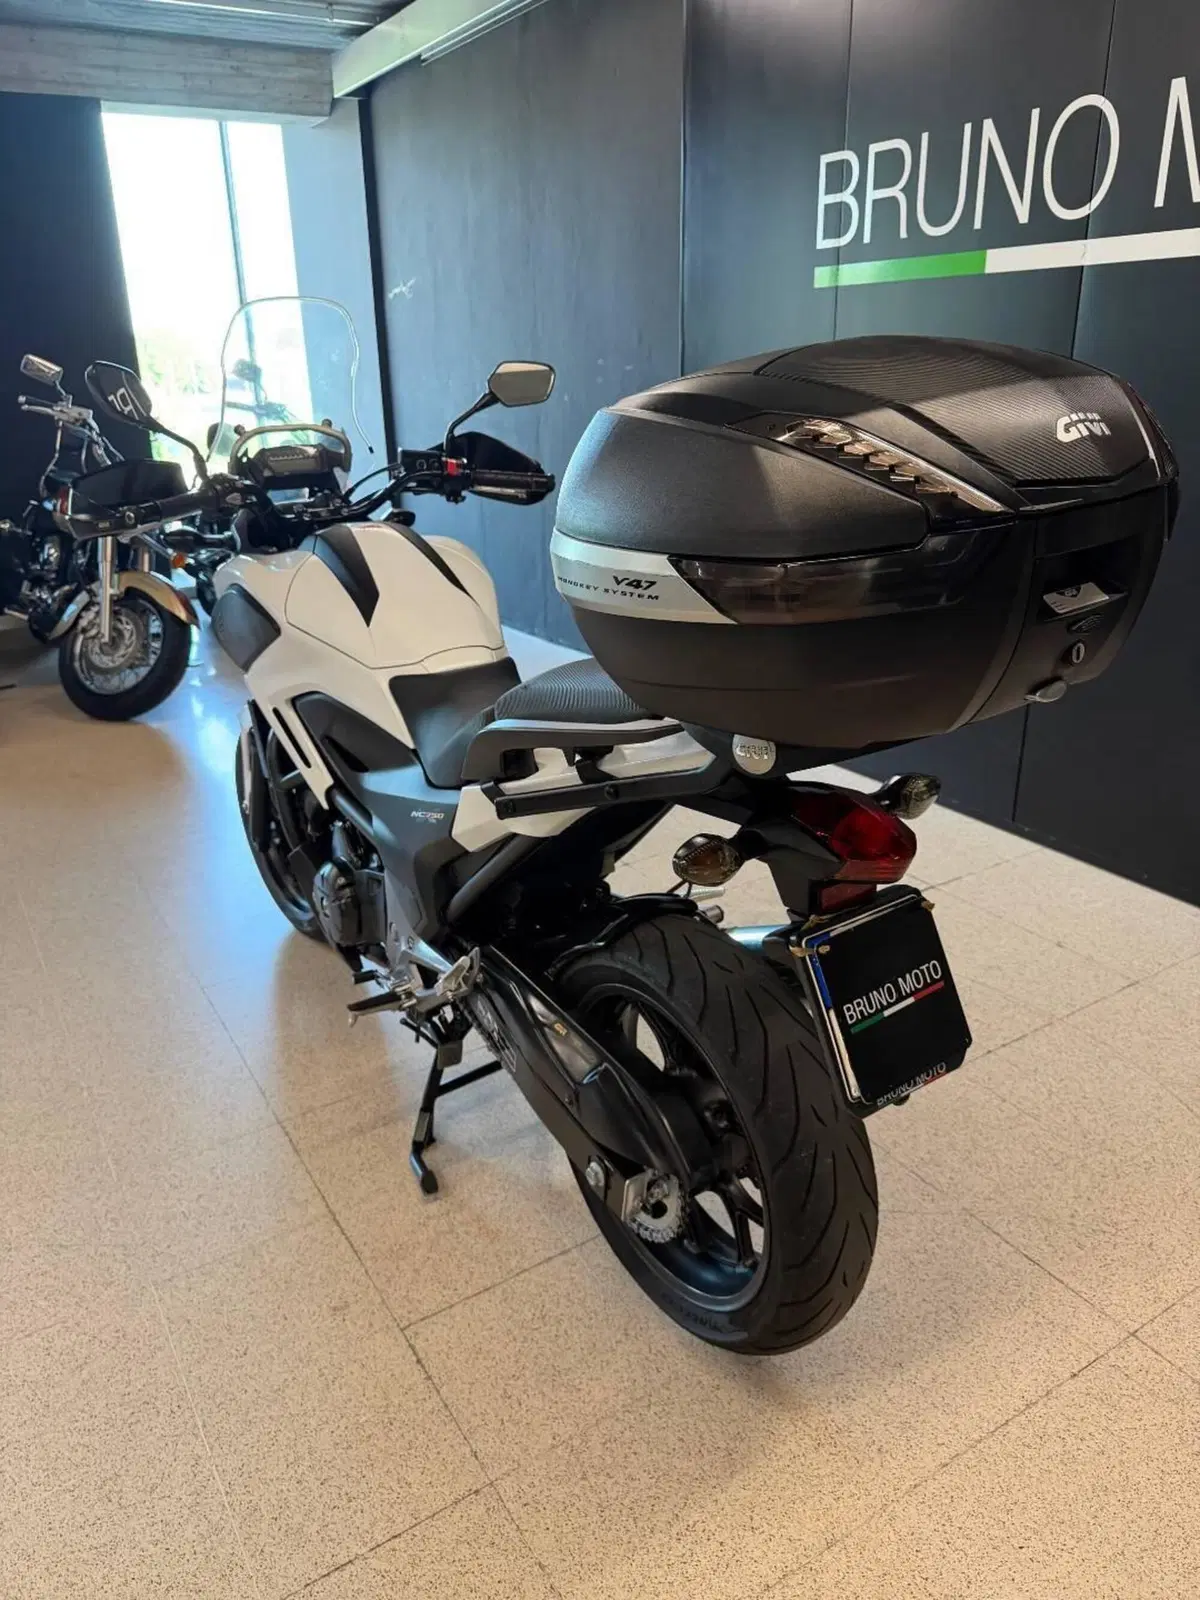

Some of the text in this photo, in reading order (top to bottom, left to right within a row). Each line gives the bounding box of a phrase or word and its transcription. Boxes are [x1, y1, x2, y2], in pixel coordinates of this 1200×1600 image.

[815, 93, 1120, 250] BRUNO
[603, 587, 659, 601] SYSTEM
[612, 575, 657, 591] V47
[842, 960, 943, 1025] BRUNO MOTO
